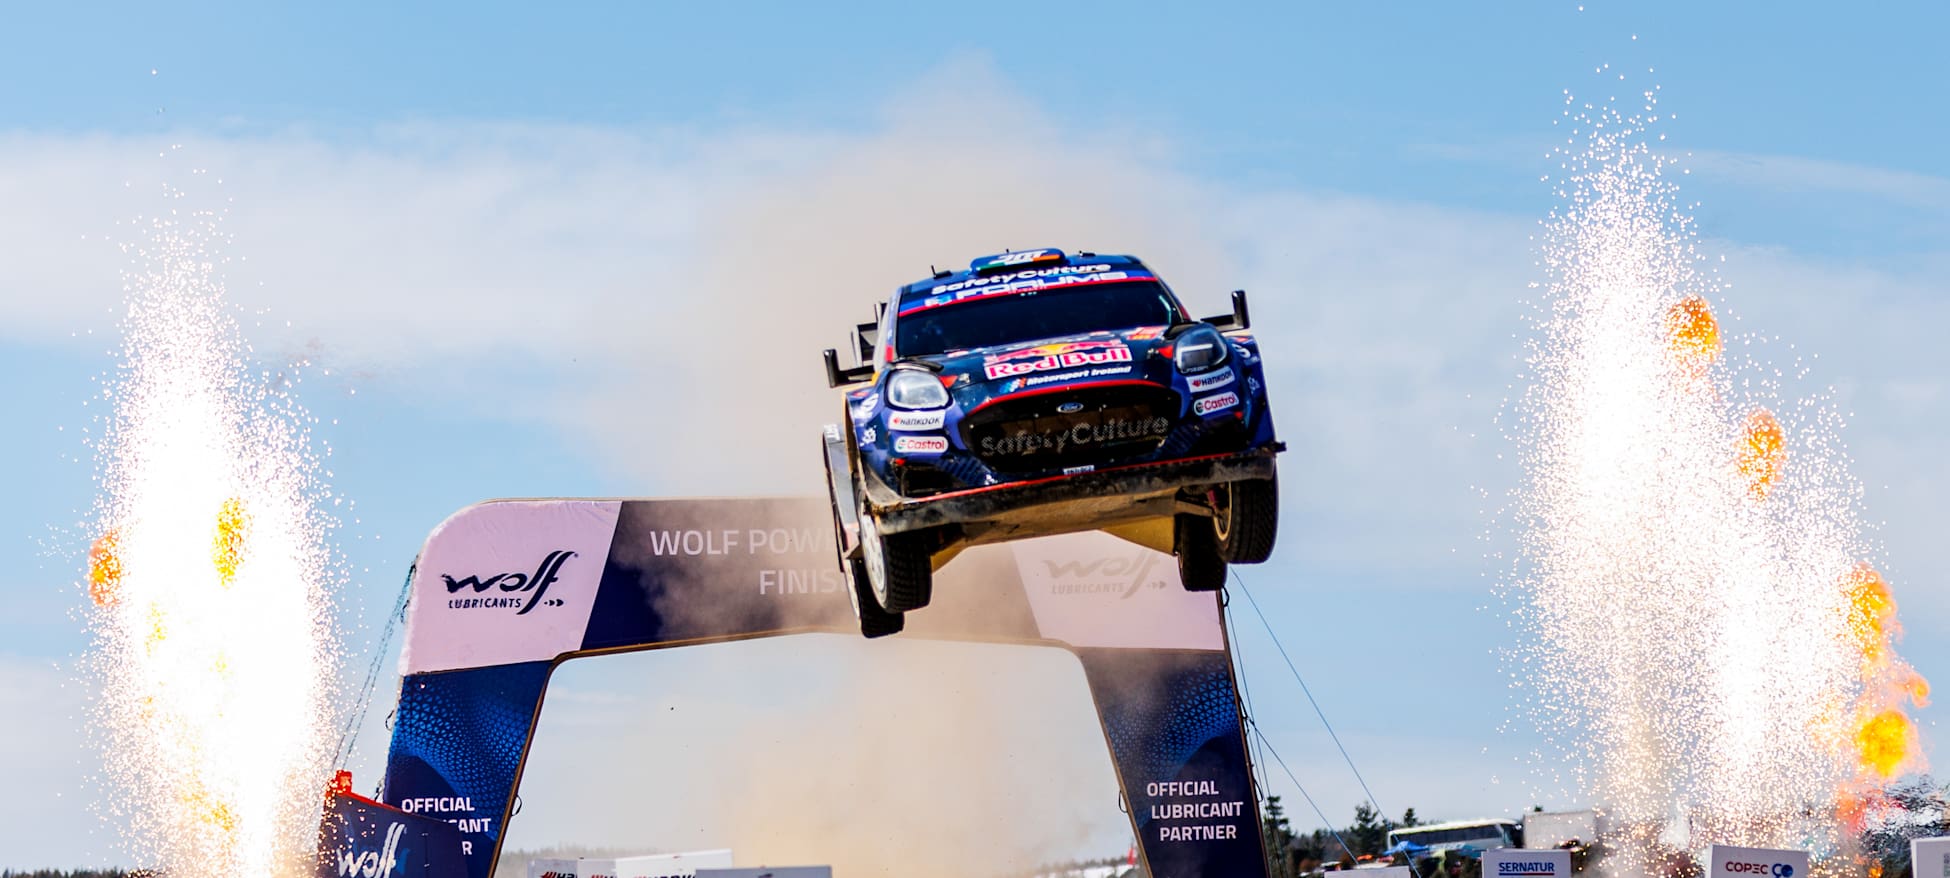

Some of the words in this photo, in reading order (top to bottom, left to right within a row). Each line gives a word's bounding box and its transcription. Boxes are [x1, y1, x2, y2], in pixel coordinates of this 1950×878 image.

[931, 264, 1111, 295] SafetyCulture
[984, 354, 1060, 380] Red
[1060, 347, 1132, 367] Bull
[1027, 370, 1089, 386] Motorsport
[1204, 394, 1236, 411] Castrol
[907, 439, 945, 450] Castrol
[980, 416, 1169, 457] SafetyCulture
[650, 530, 739, 556] WOLF
[749, 528, 837, 554] POWE
[759, 569, 844, 595] FINIS
[1051, 582, 1125, 595] LUBRICANTS
[448, 598, 521, 609] LUBRICANTS
[1146, 781, 1219, 797] OFFICIAL
[401, 797, 475, 813] OFFICIAL
[1151, 801, 1244, 819] LUBRICANT
[1160, 825, 1237, 841] PARTNER
[1498, 862, 1555, 872] SERNATUR
[1725, 861, 1769, 874] COPEC
